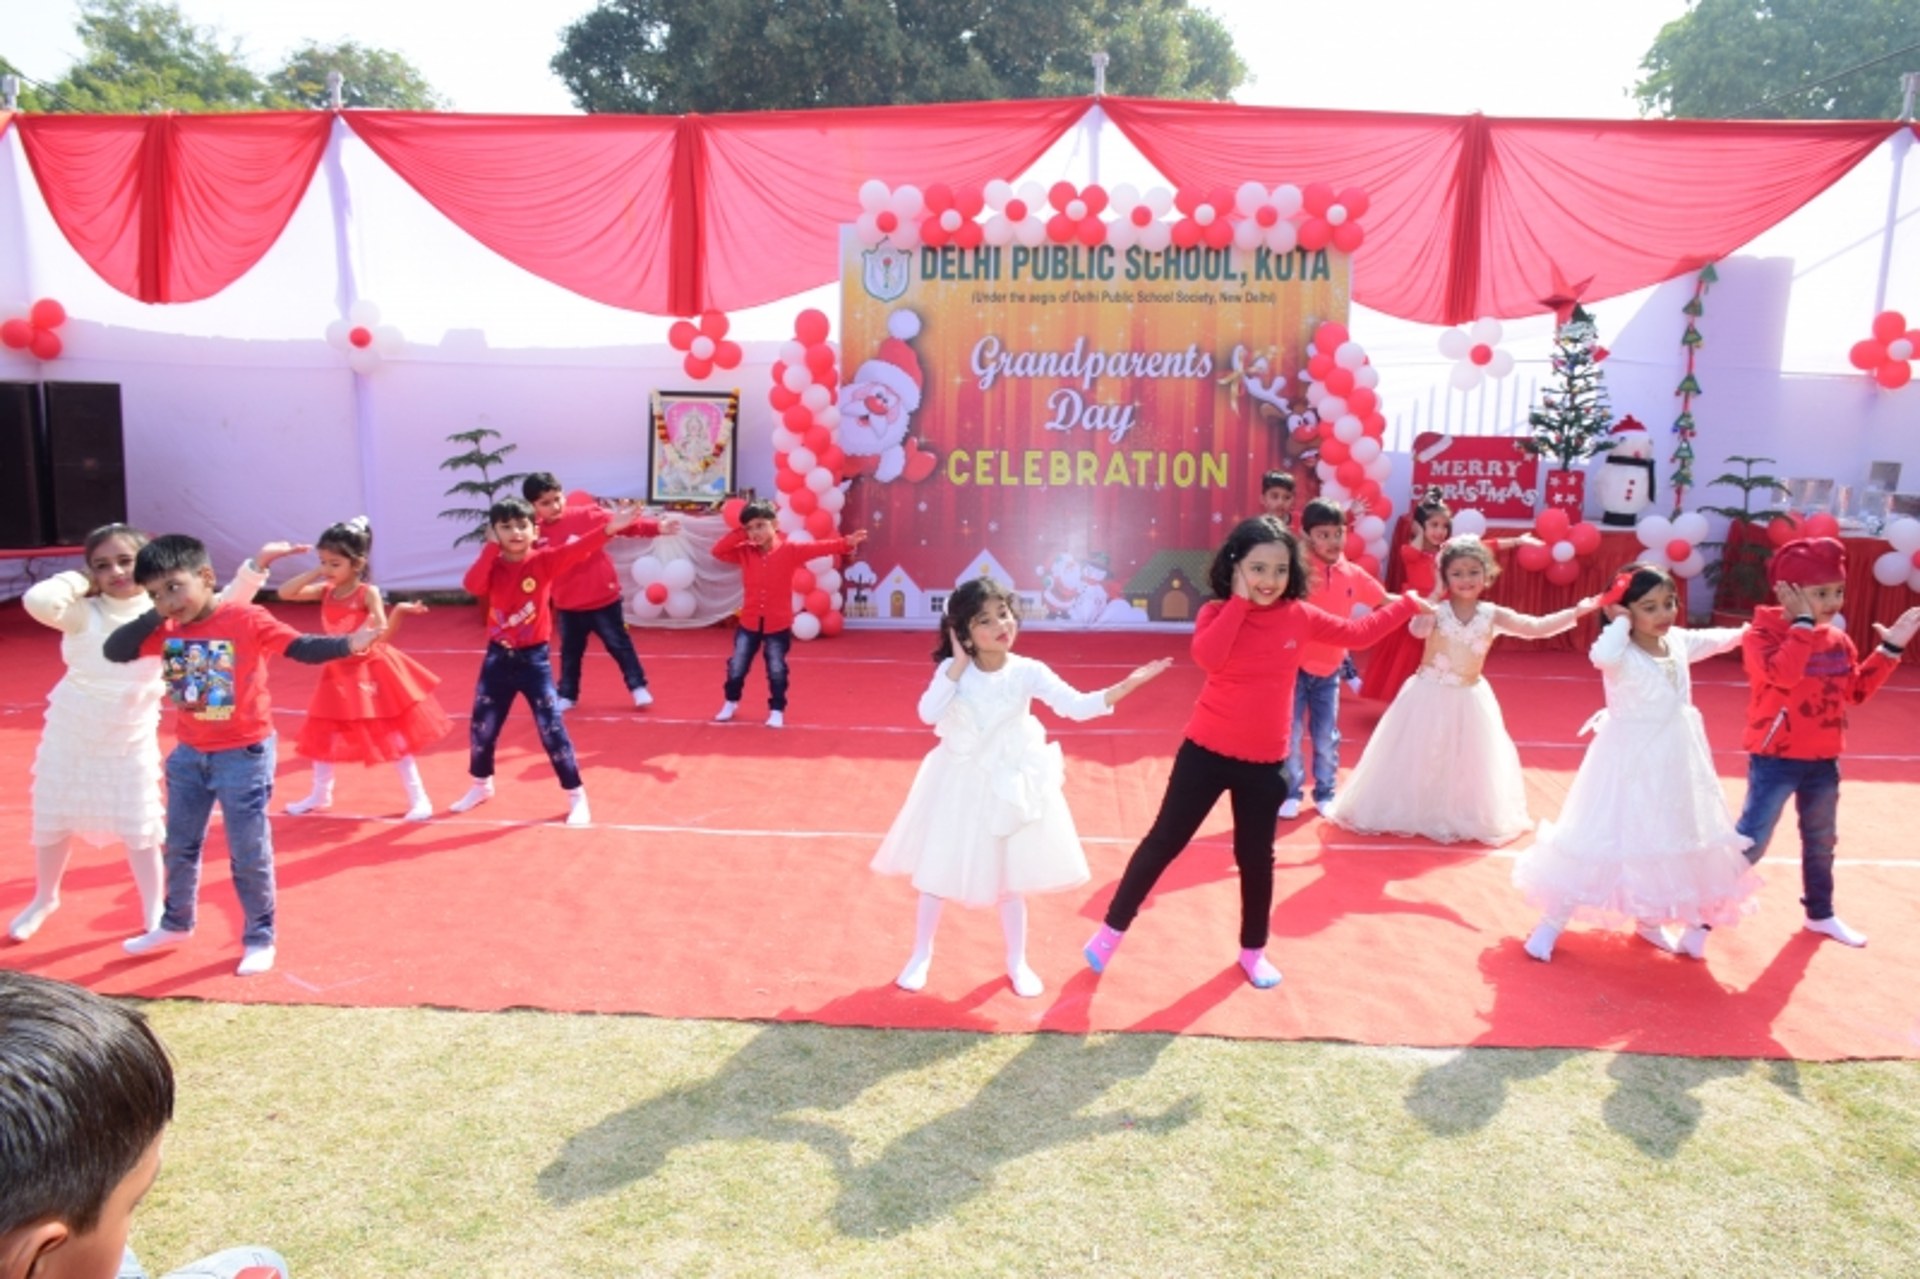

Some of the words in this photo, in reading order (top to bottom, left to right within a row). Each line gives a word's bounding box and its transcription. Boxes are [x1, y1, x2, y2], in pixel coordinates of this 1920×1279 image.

[920, 244, 1001, 281] DELHI
[1012, 244, 1115, 281] PUBLIC
[1125, 244, 1249, 286] SCHOOL,
[1255, 244, 1331, 281] KOTA
[971, 289, 1006, 304] (Under
[1010, 290, 1026, 303] the
[1029, 293, 1056, 305] aegis
[1059, 290, 1072, 303] of
[1072, 290, 1099, 303] Delhi
[1101, 290, 1133, 304] Public
[1137, 290, 1174, 304] School
[1219, 291, 1242, 304] New
[970, 335, 1213, 390] Grandparents
[1044, 388, 1136, 444] Day
[948, 449, 1229, 488] CELEBRATION
[1430, 460, 1521, 478] MERRY
[1412, 479, 1538, 507] CRISTMAS
